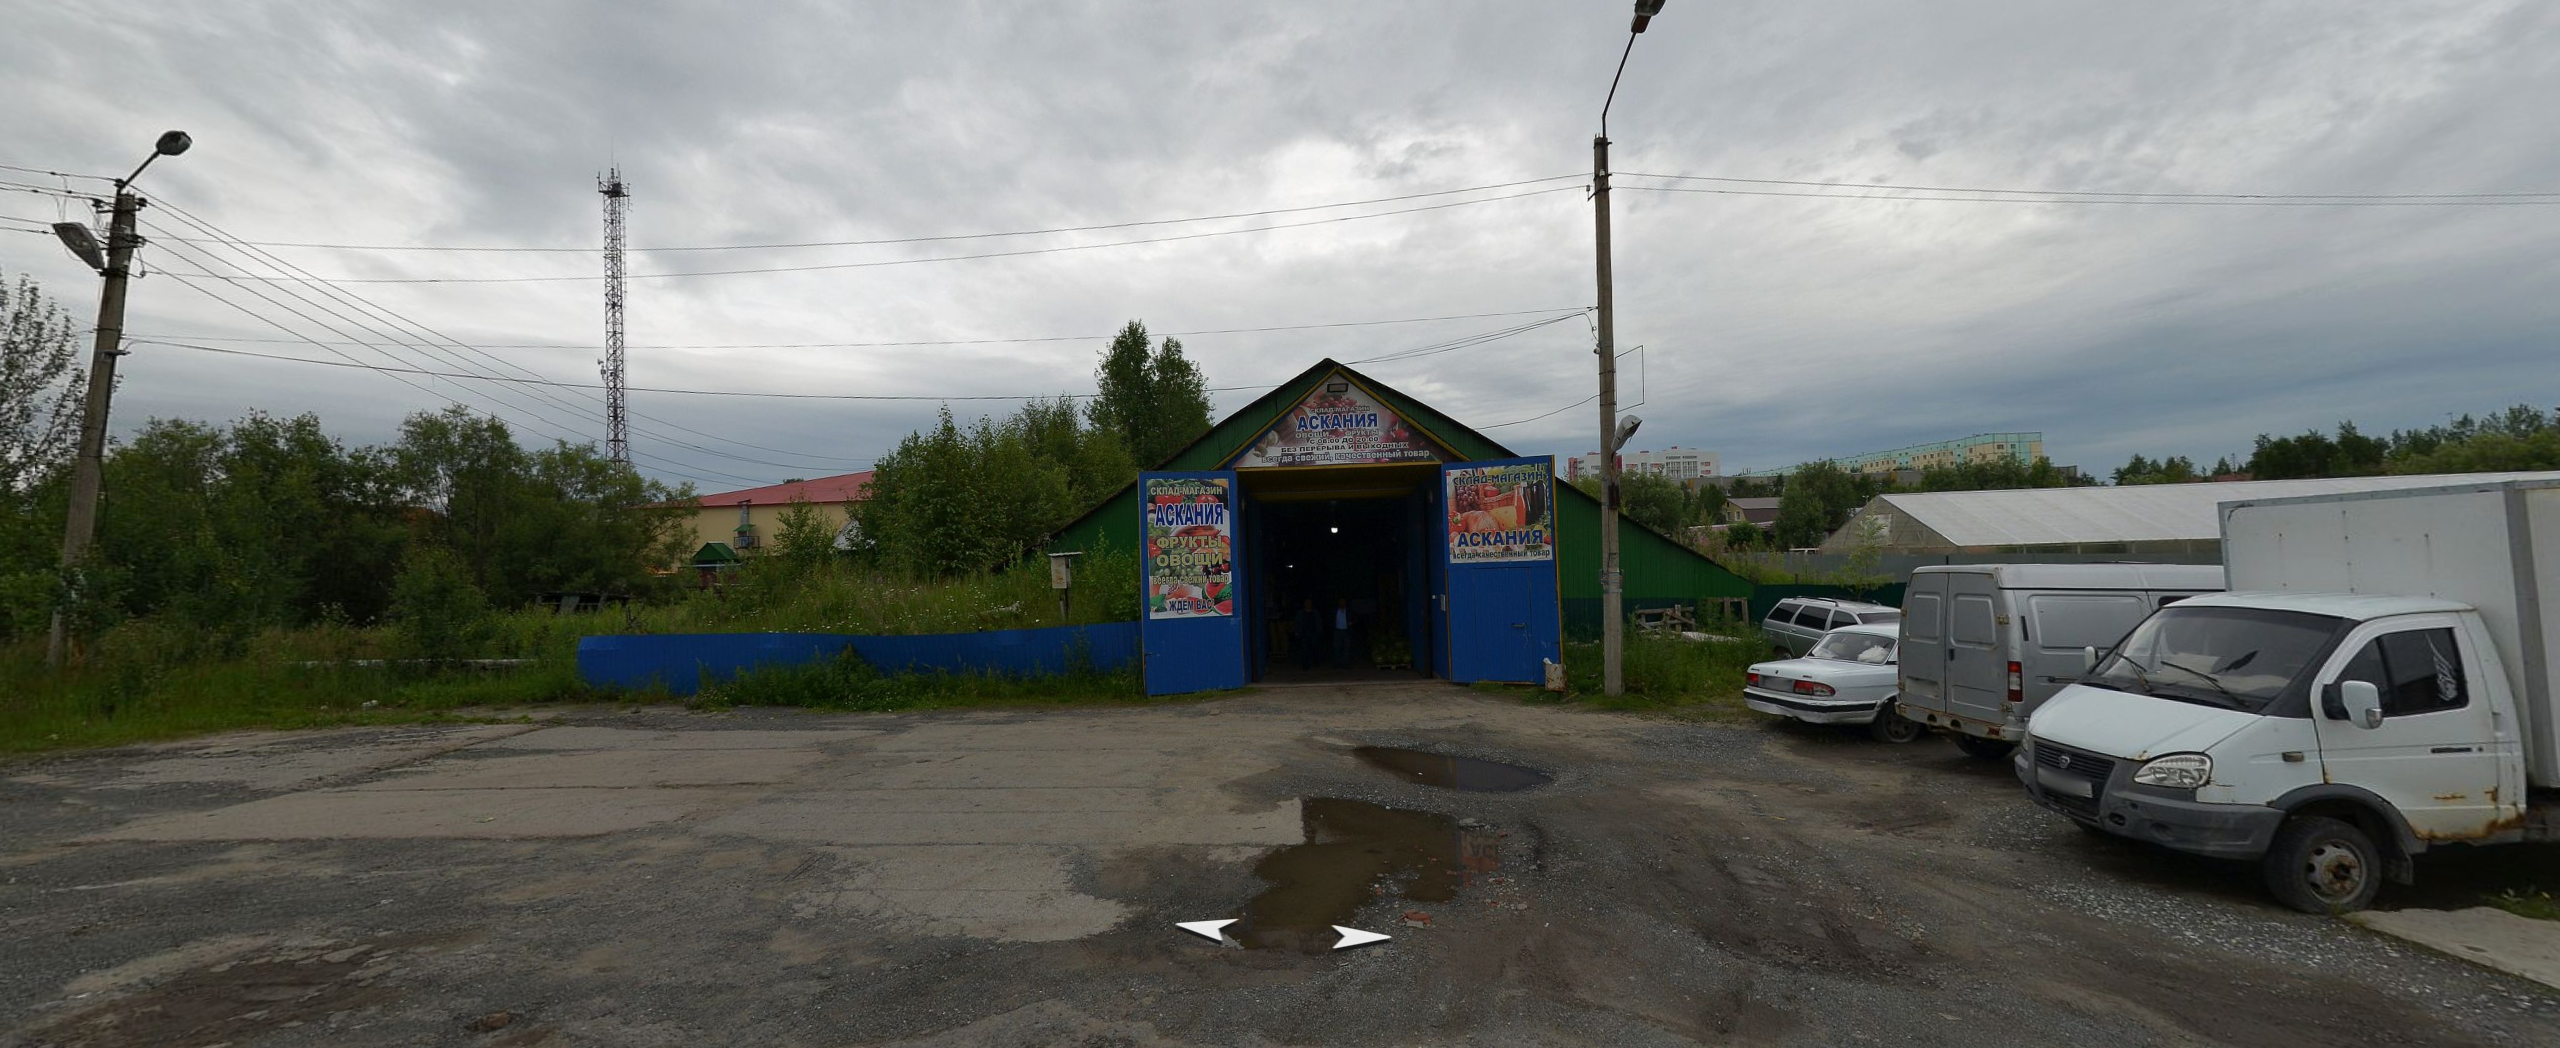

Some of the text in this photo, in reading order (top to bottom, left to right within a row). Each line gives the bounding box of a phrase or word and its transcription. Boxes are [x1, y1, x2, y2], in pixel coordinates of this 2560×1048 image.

[1297, 413, 1378, 431] АСКАНИЯ
[1295, 431, 1329, 439] ОВОЩИ
[1299, 444, 1345, 452] ПЕРЕРЫВА
[1356, 441, 1409, 450] ВЫХОДНЫХ
[1262, 455, 1293, 463] всегда
[1334, 449, 1402, 460] качественный
[1403, 450, 1430, 459] товар
[1453, 471, 1543, 486] СКЛАД-МАГАЗИН
[1150, 486, 1223, 496] СКЛАД-МАГАЗИН
[1154, 503, 1224, 526] АСКАНИЯ
[1156, 535, 1222, 549] ФРУКТЫ
[1457, 529, 1543, 548] АСКАНИЯ
[1156, 552, 1223, 567] ОВОЩИ
[1529, 549, 1550, 557] товар
[1152, 576, 1178, 585] всегда
[1208, 574, 1230, 584] товар
[1169, 600, 1193, 613] ЖДЕМ
